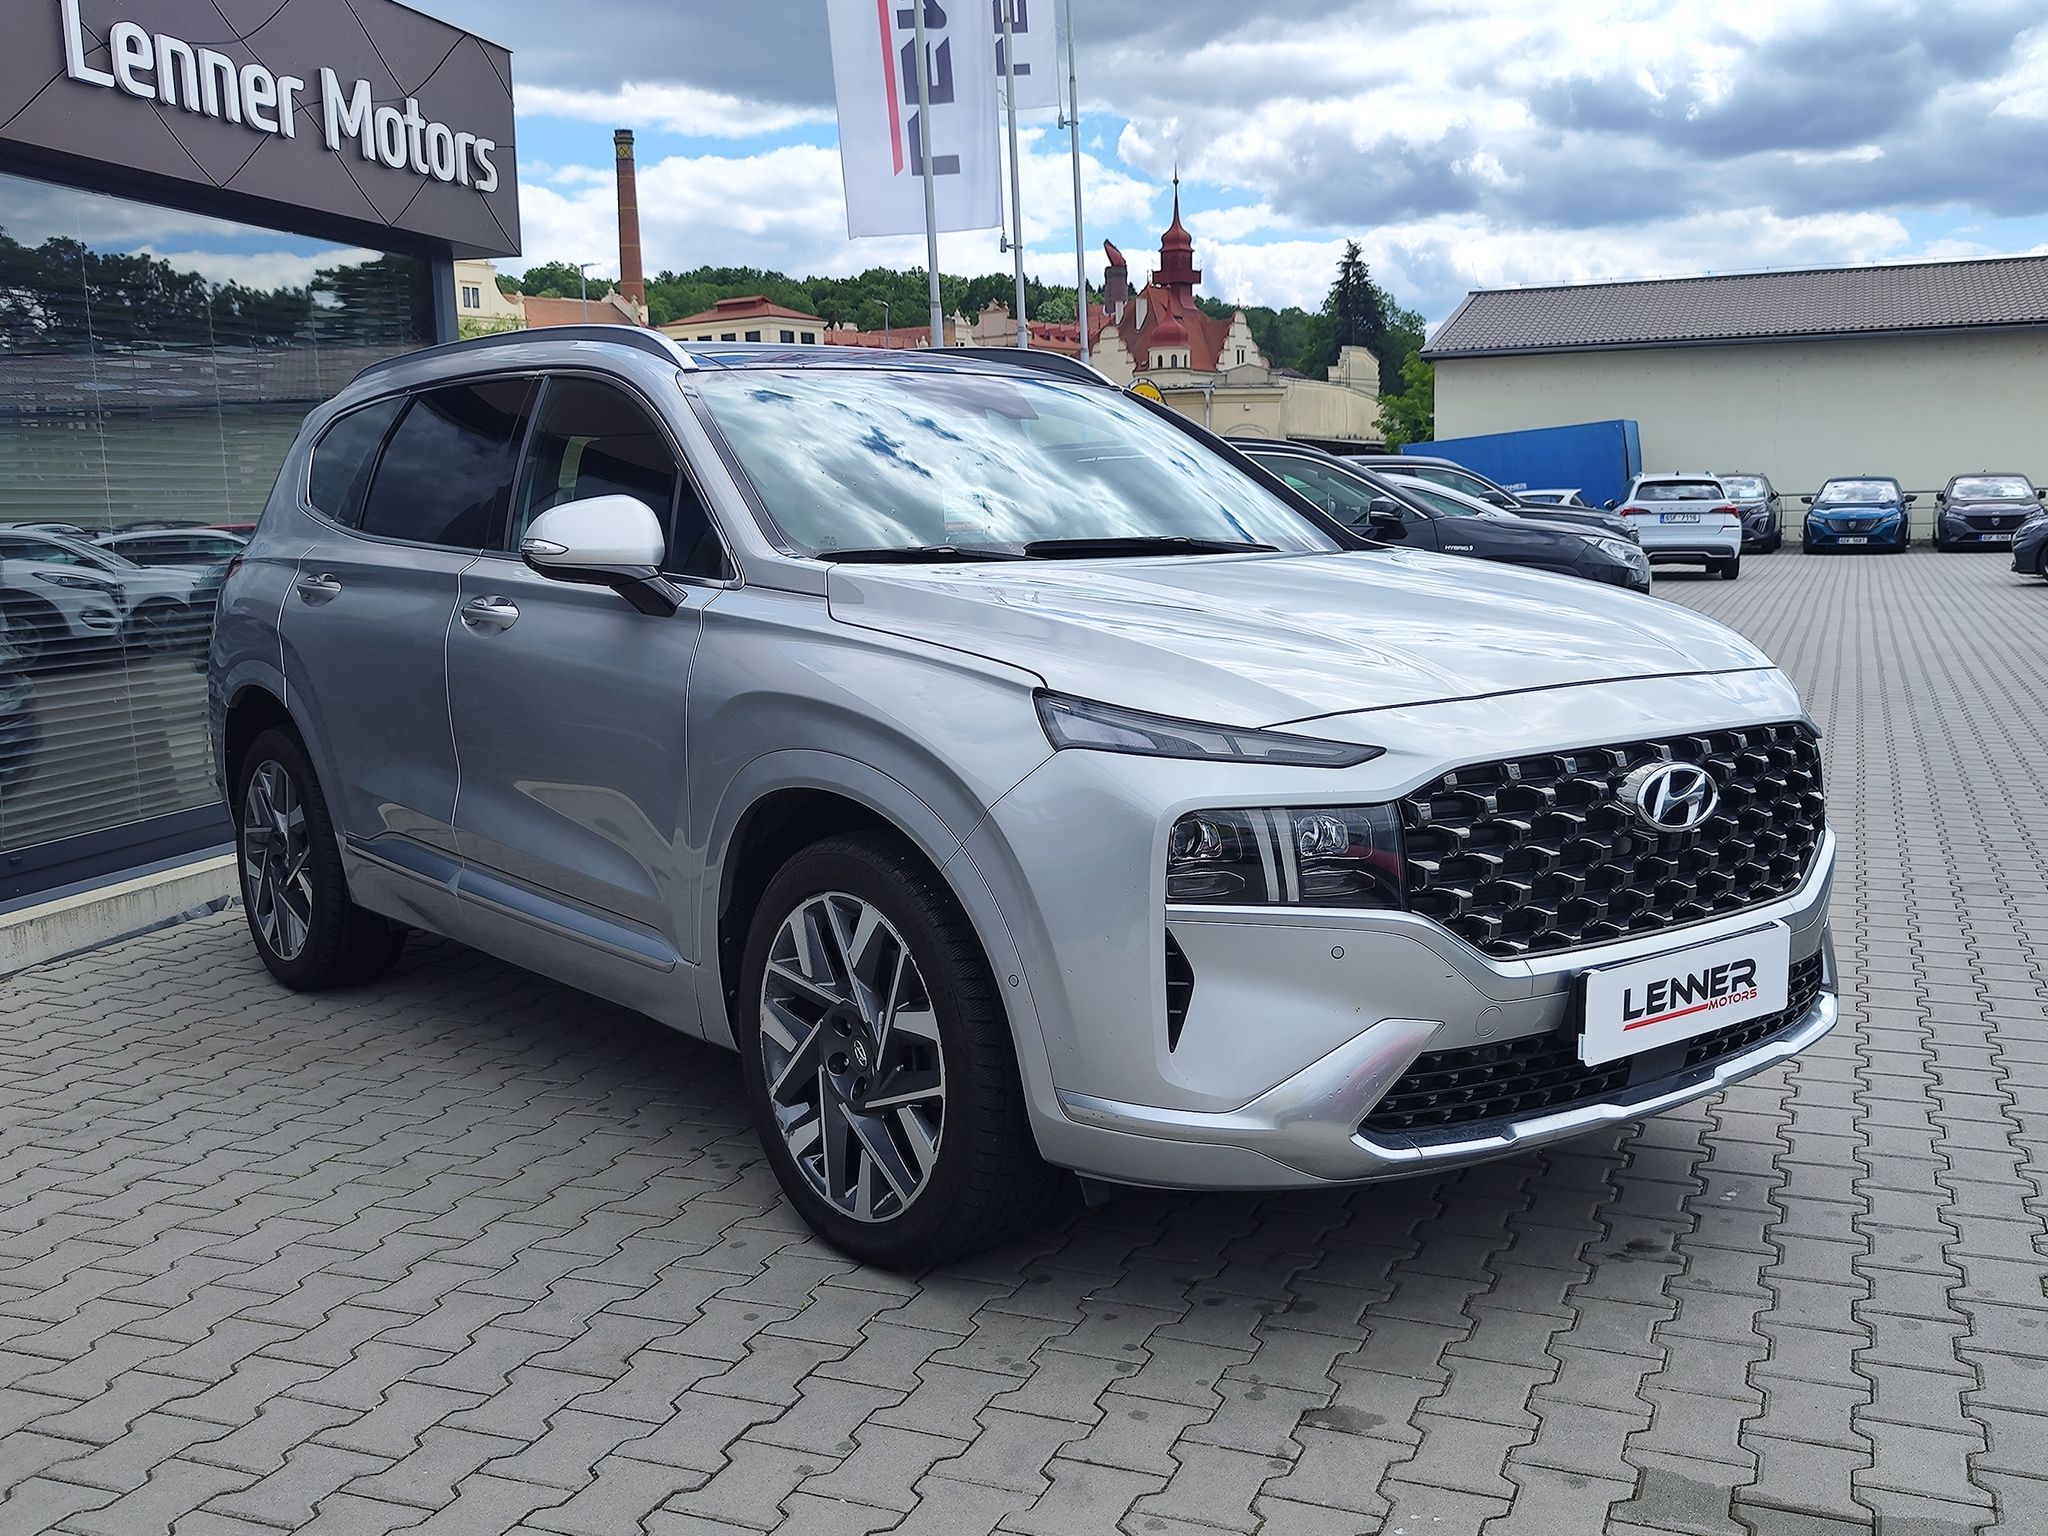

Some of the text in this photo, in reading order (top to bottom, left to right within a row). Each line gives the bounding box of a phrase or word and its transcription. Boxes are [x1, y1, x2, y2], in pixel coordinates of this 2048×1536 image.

[61, 0, 500, 193] Lenner Motors
[1623, 958, 1757, 1021] LENNER
[1708, 987, 1757, 1010] MOTORS
